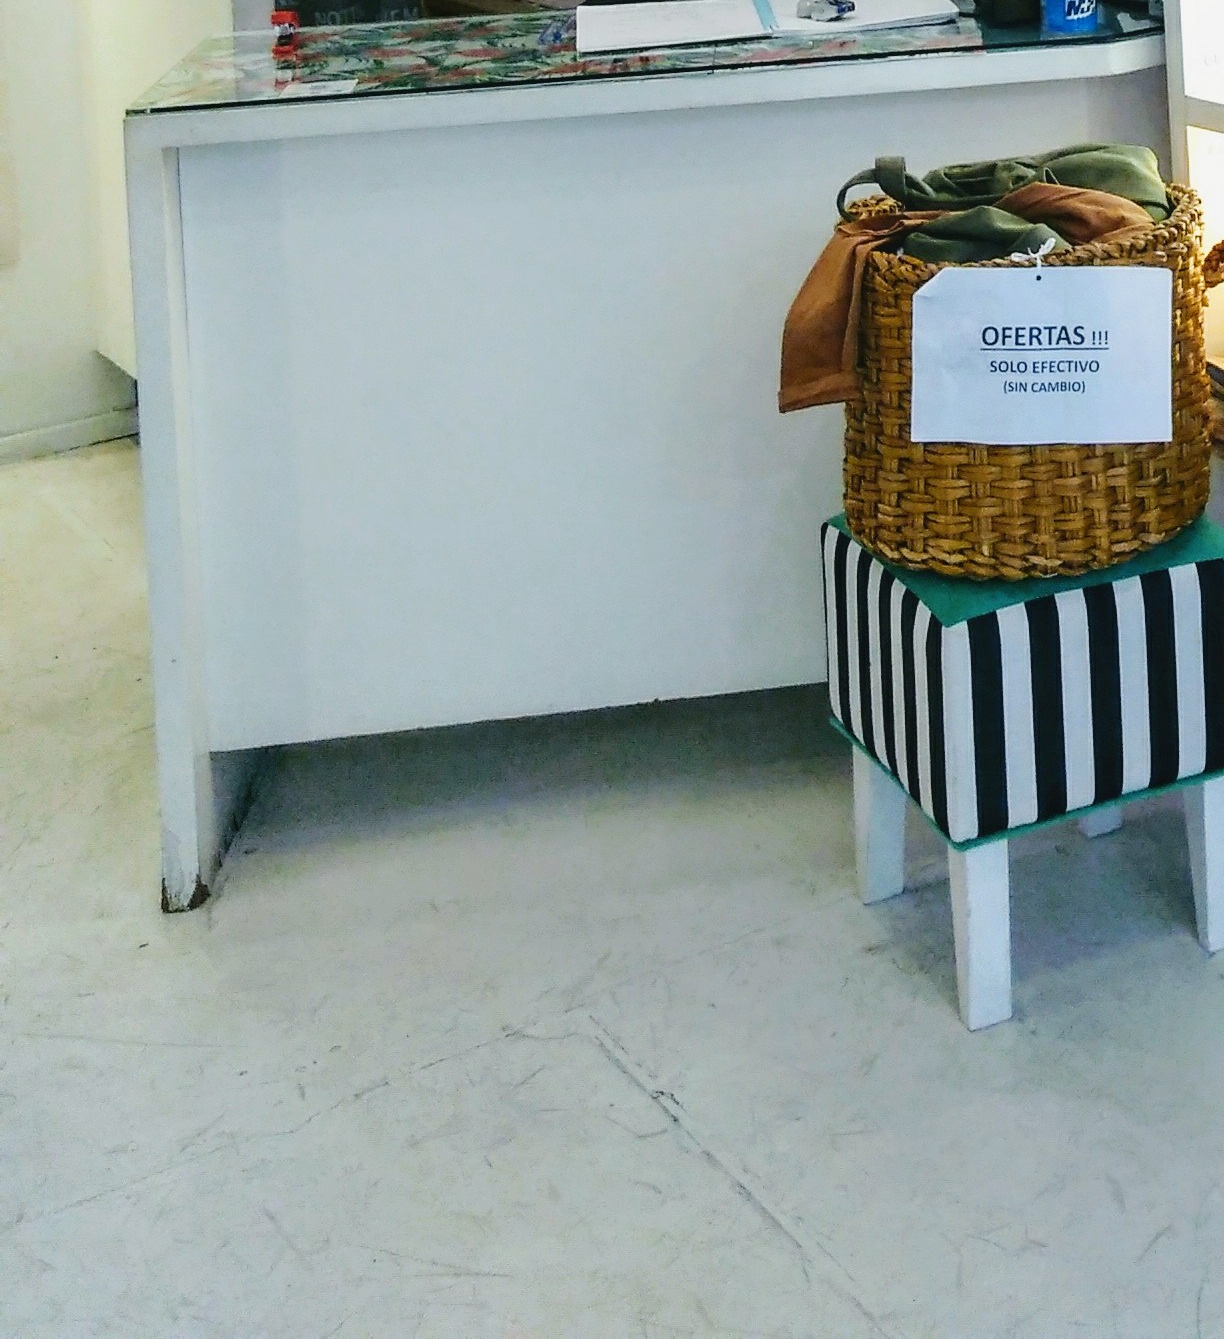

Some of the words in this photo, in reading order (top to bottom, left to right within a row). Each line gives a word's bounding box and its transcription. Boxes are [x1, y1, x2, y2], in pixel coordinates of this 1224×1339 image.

[981, 325, 1085, 347] OFERTAS
[1091, 330, 1109, 346] !!!
[990, 360, 1028, 374] SOLO
[1032, 360, 1100, 374] EFECTIVO
[1003, 381, 1027, 394] (SIN
[1031, 381, 1086, 394] CAMBIO)
